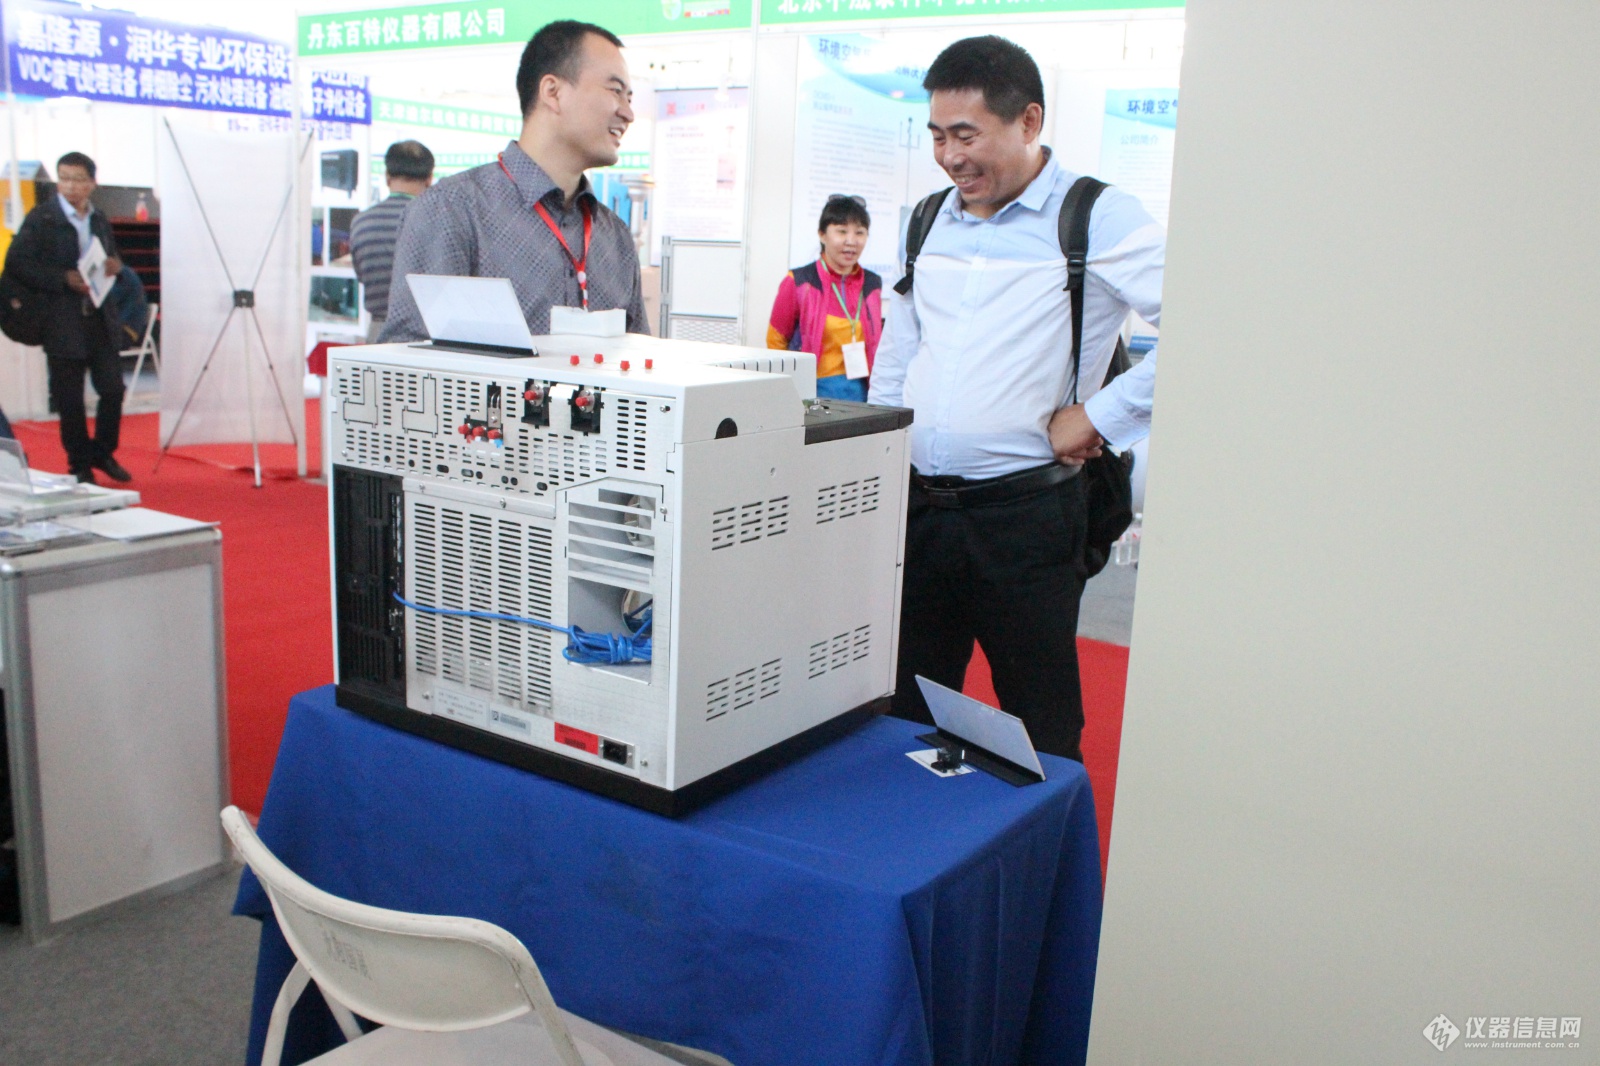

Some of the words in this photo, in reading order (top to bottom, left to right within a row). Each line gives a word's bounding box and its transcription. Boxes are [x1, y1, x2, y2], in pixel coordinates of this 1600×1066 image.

[307, 8, 506, 49] 丹东百特仪器有限公司
[1120, 134, 1159, 145] 公司简介
